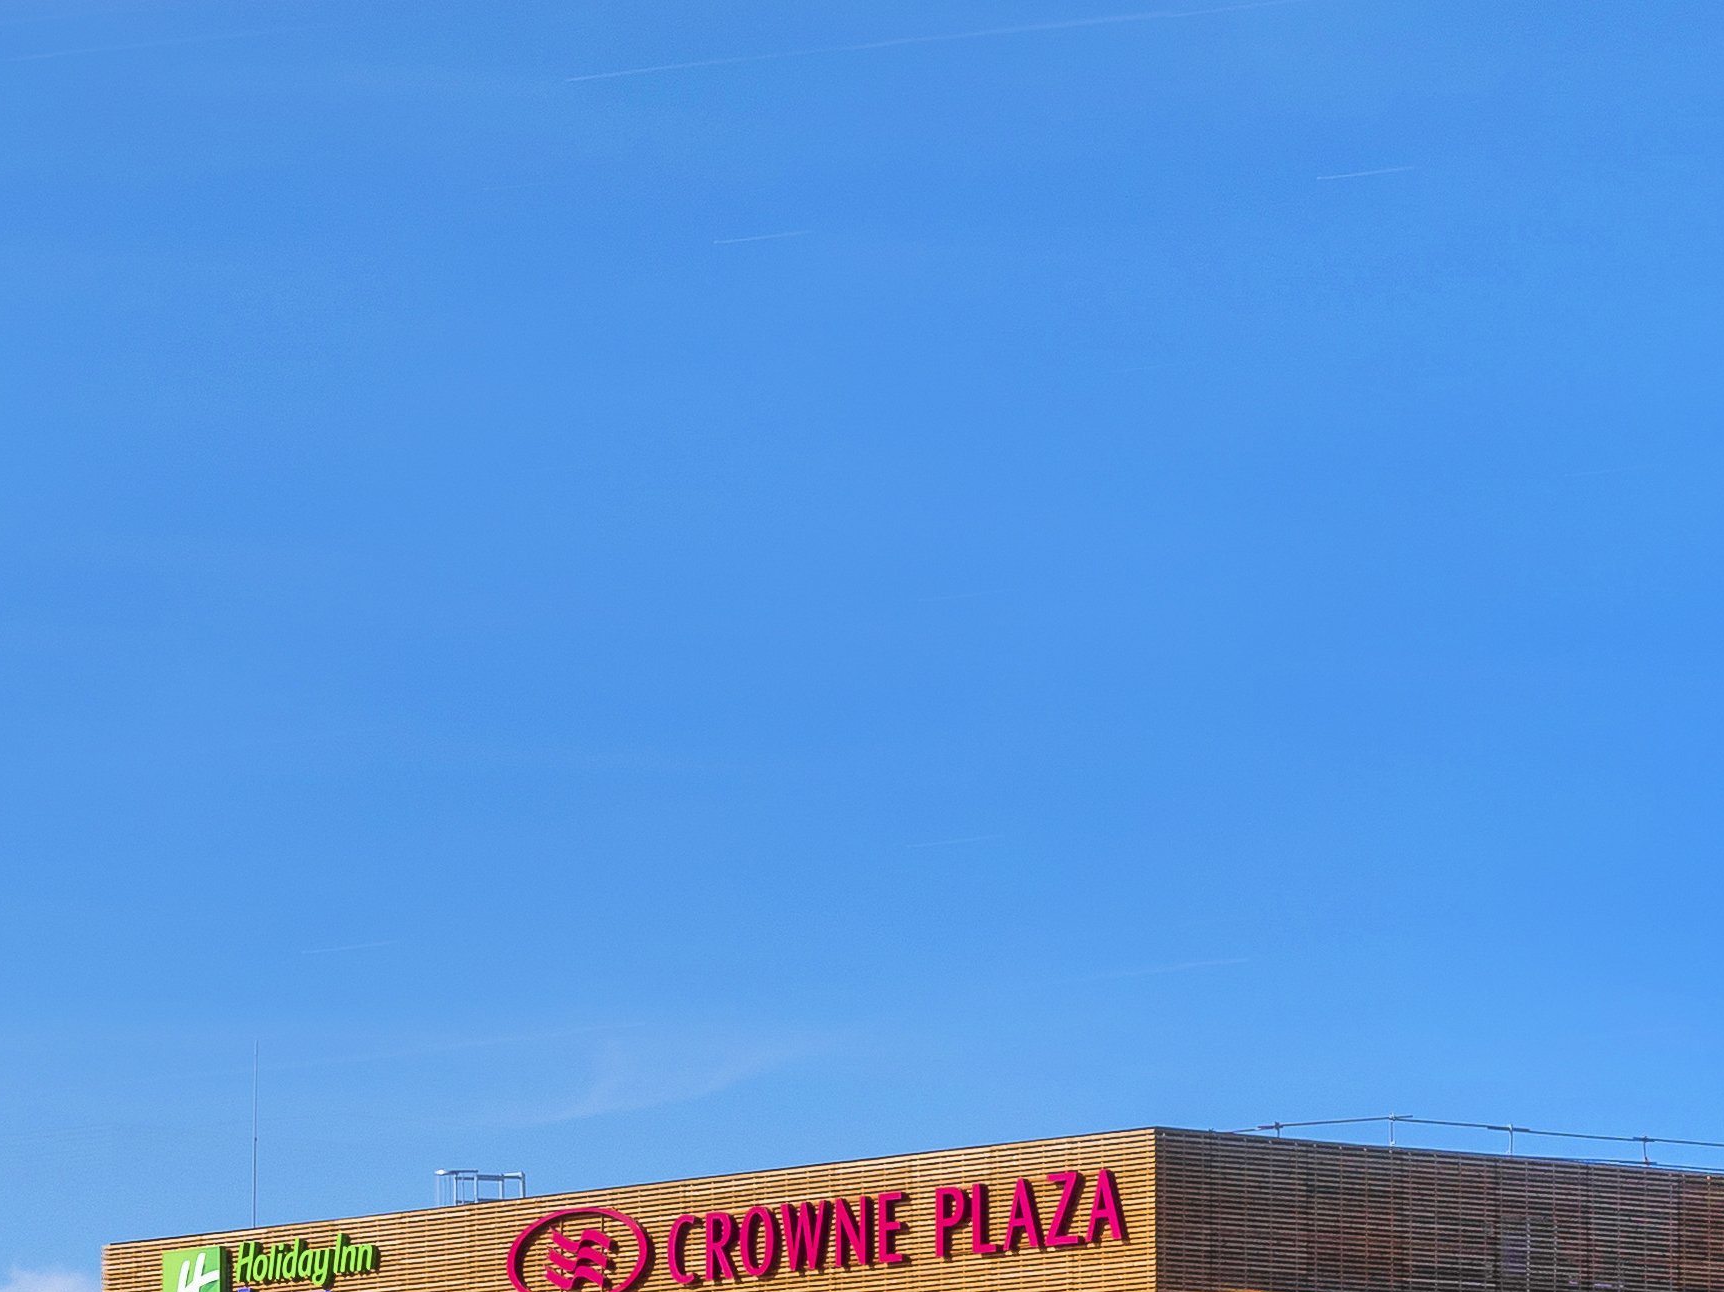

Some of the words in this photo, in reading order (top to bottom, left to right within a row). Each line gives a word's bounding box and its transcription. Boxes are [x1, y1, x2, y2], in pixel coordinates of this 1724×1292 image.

[234, 1237, 331, 1287] Holiday
[333, 1232, 375, 1274] Inn
[667, 1191, 906, 1286] CROWNE
[935, 1168, 1124, 1258] PLAZA
